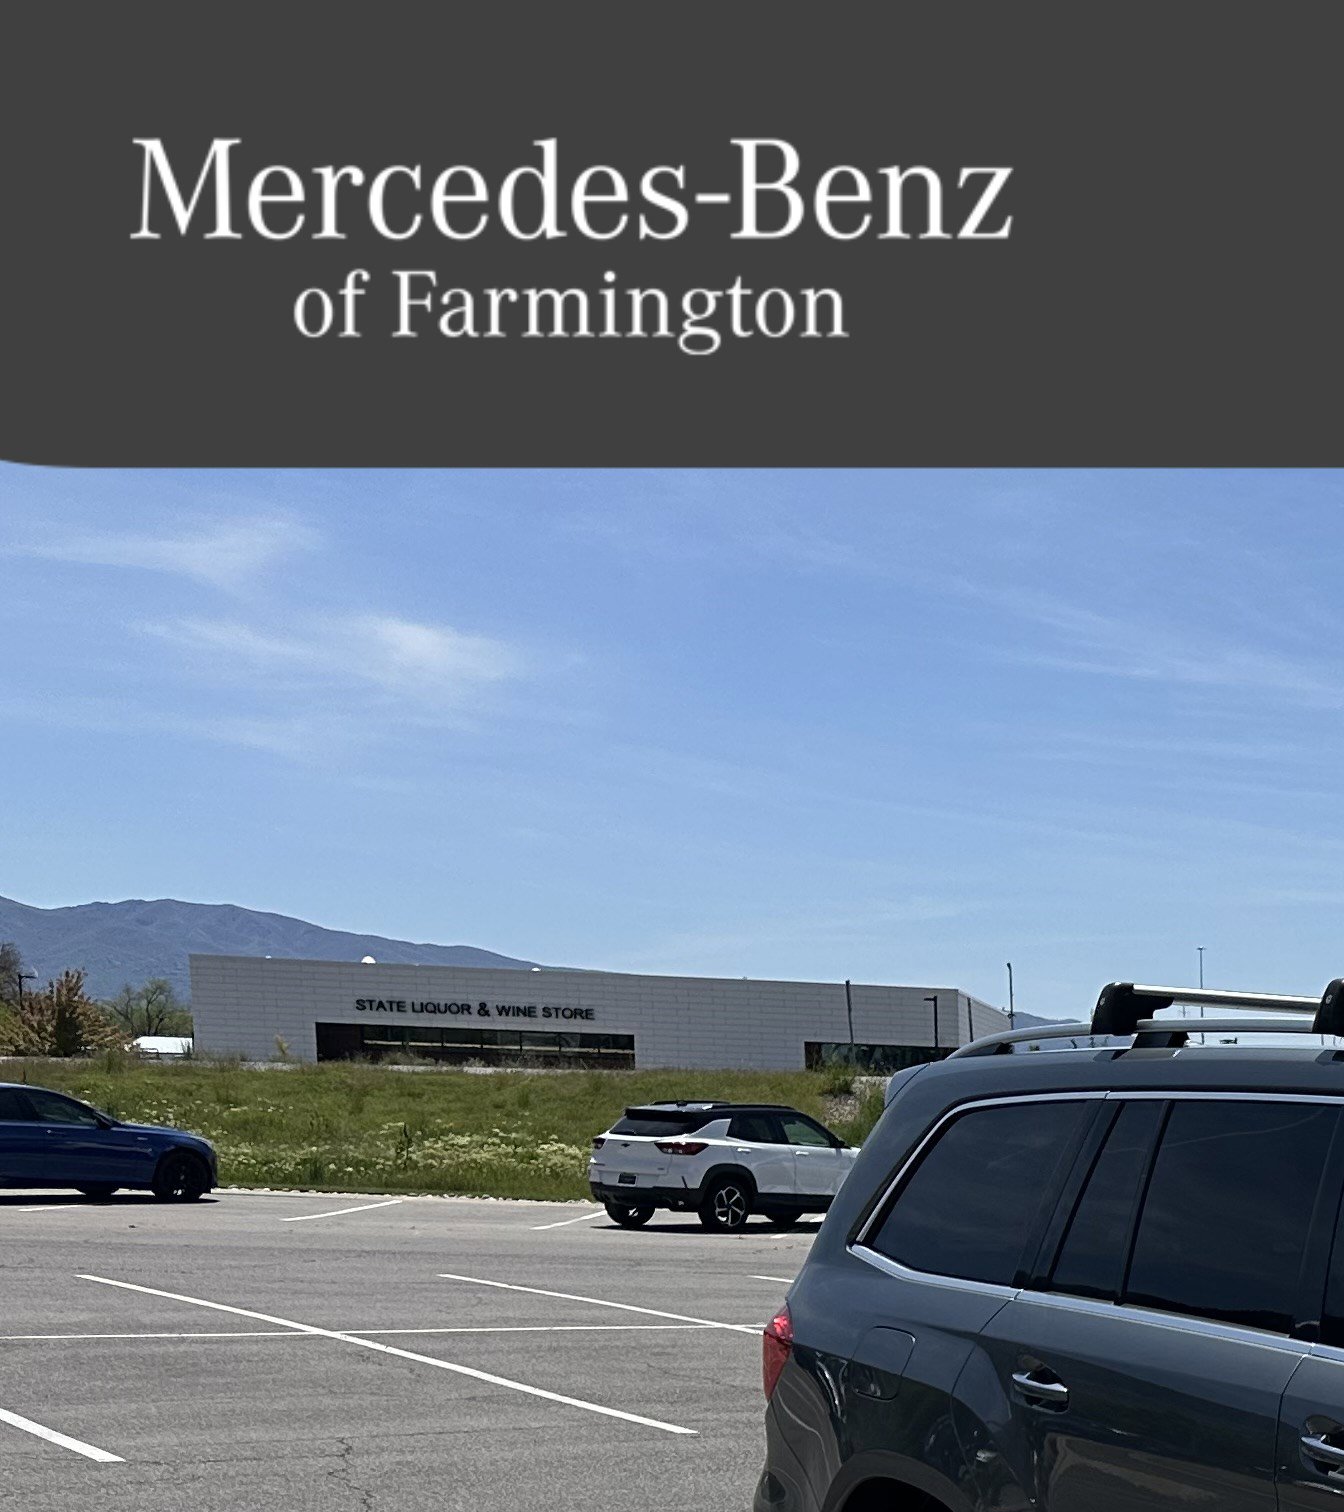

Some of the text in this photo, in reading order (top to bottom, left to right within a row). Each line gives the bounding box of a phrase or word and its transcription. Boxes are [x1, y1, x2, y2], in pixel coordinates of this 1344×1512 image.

[355, 998, 596, 1020] STATE LIQUOR & WINE STORE
